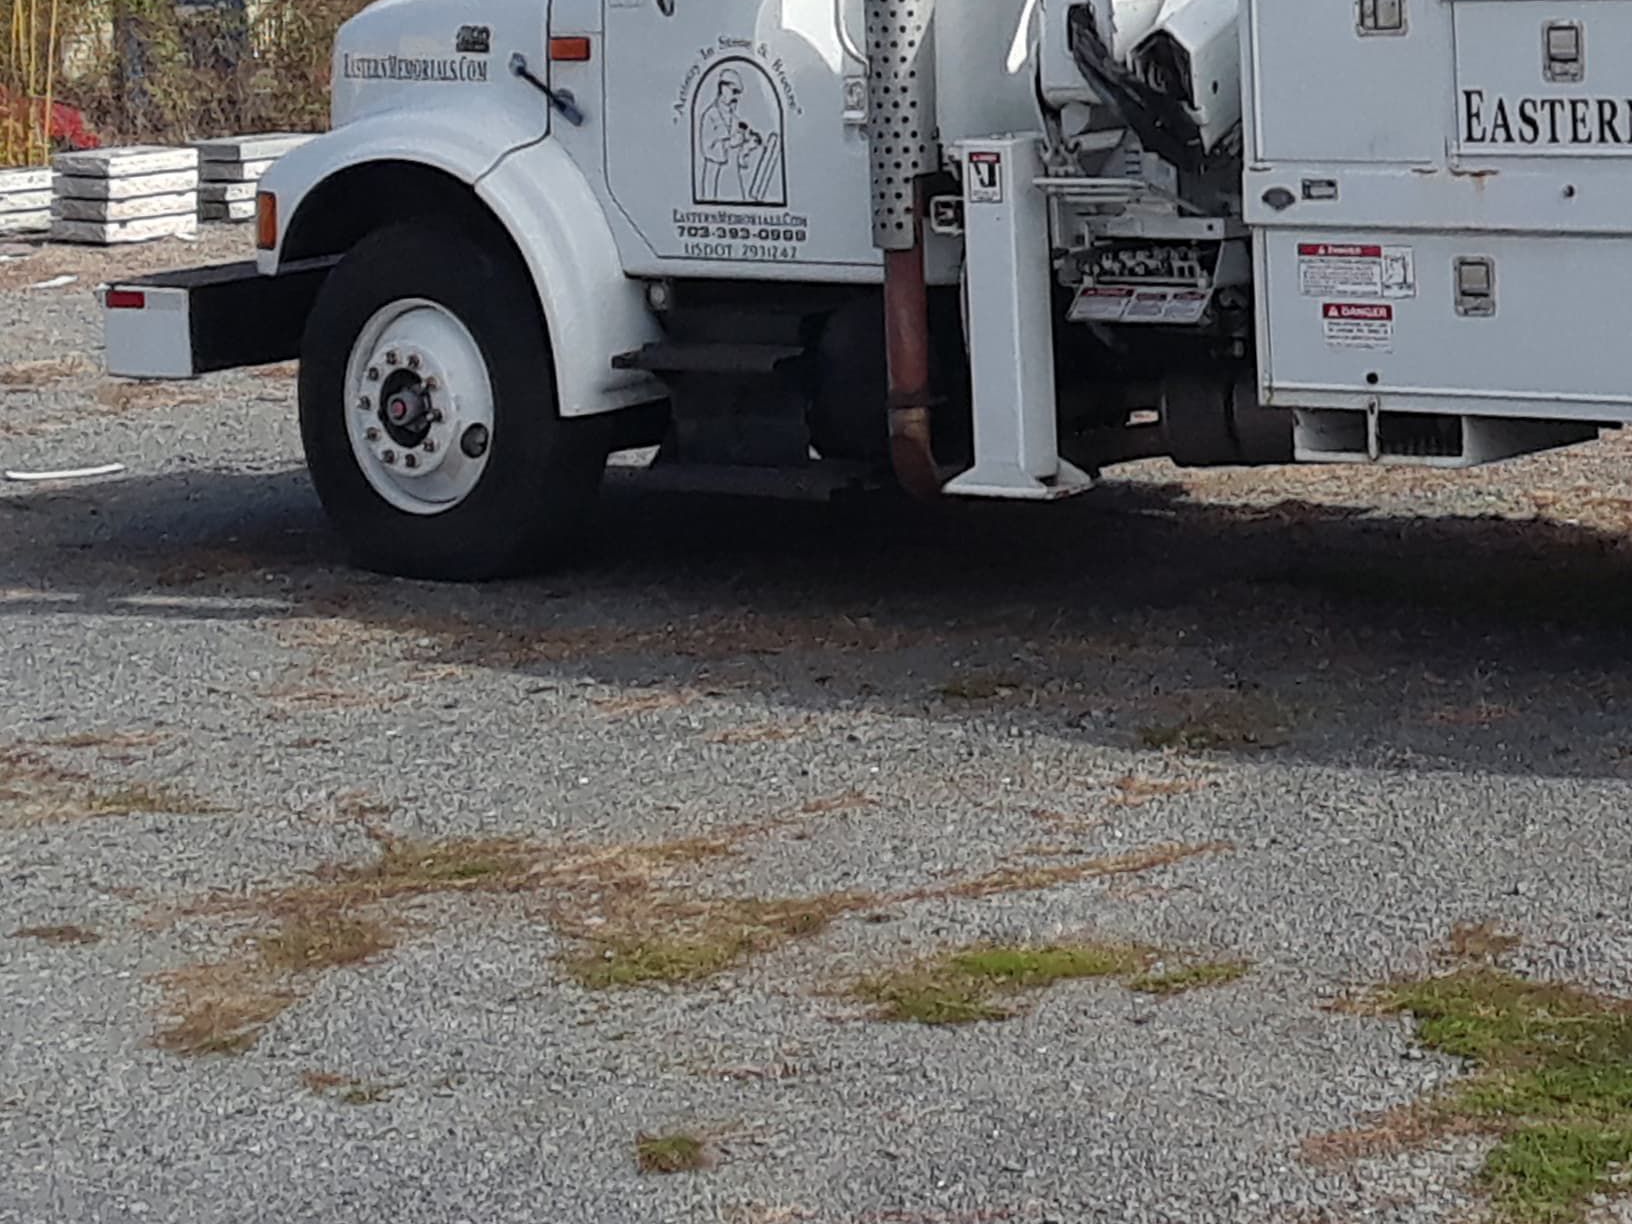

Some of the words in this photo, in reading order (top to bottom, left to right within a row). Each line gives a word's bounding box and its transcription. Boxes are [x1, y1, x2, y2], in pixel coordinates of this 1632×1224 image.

[700, 48, 715, 60] In
[677, 226, 806, 241] 703-393-0999
[684, 242, 732, 257] USDOT
[1341, 305, 1387, 319] DANGER
